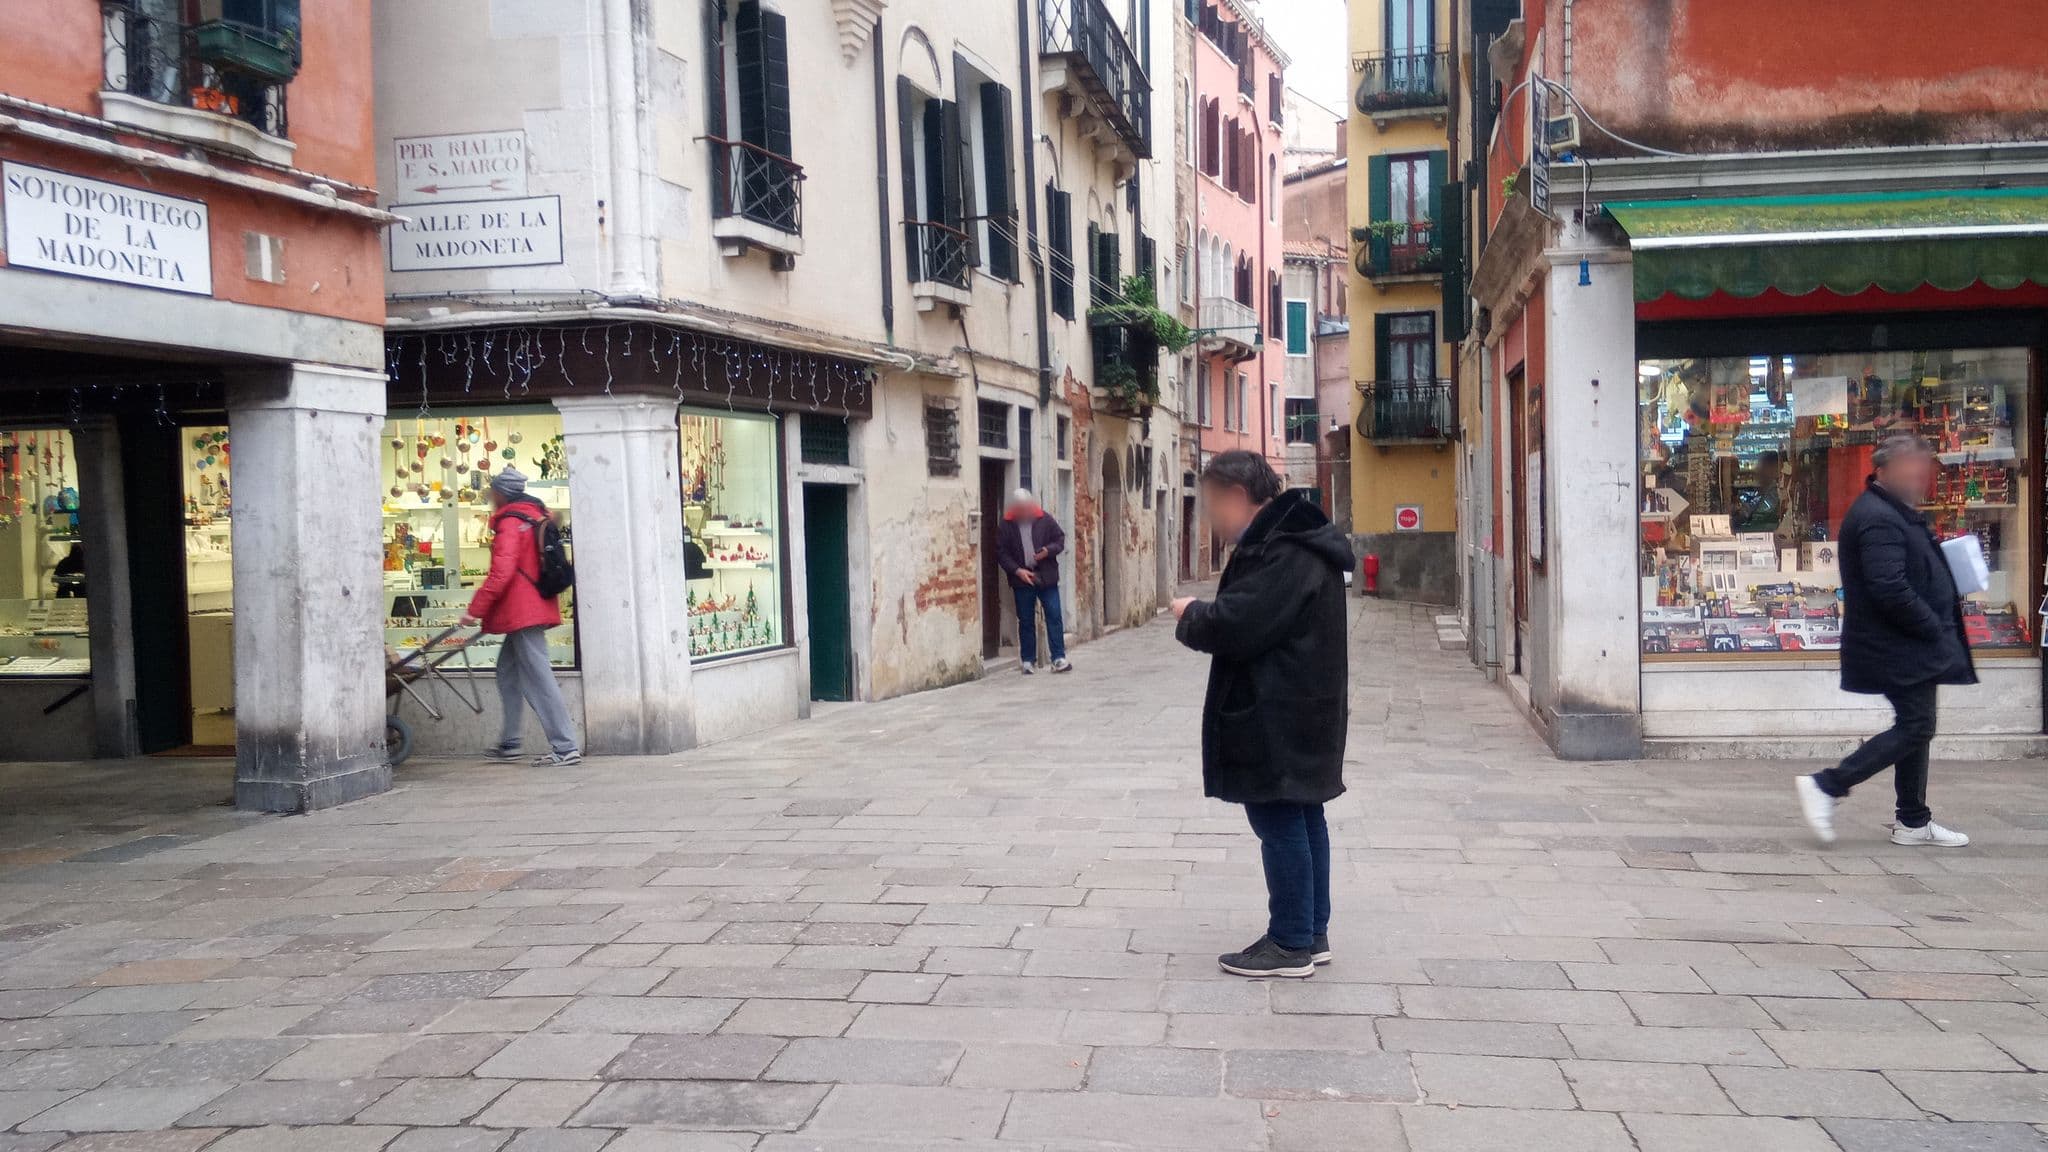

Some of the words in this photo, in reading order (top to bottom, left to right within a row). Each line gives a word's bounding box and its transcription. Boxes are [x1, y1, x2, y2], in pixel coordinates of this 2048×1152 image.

[400, 143, 434, 160] PER
[449, 137, 521, 158] RIALTO
[405, 163, 418, 179] E
[8, 172, 202, 231] SOTOPORTEGO
[65, 212, 100, 240] DE
[125, 223, 158, 250] LA
[400, 214, 470, 233] CALLE
[481, 212, 509, 229] DE
[520, 211, 547, 228] LA
[37, 236, 185, 283] MADONETA
[415, 237, 534, 259] MADONETA
